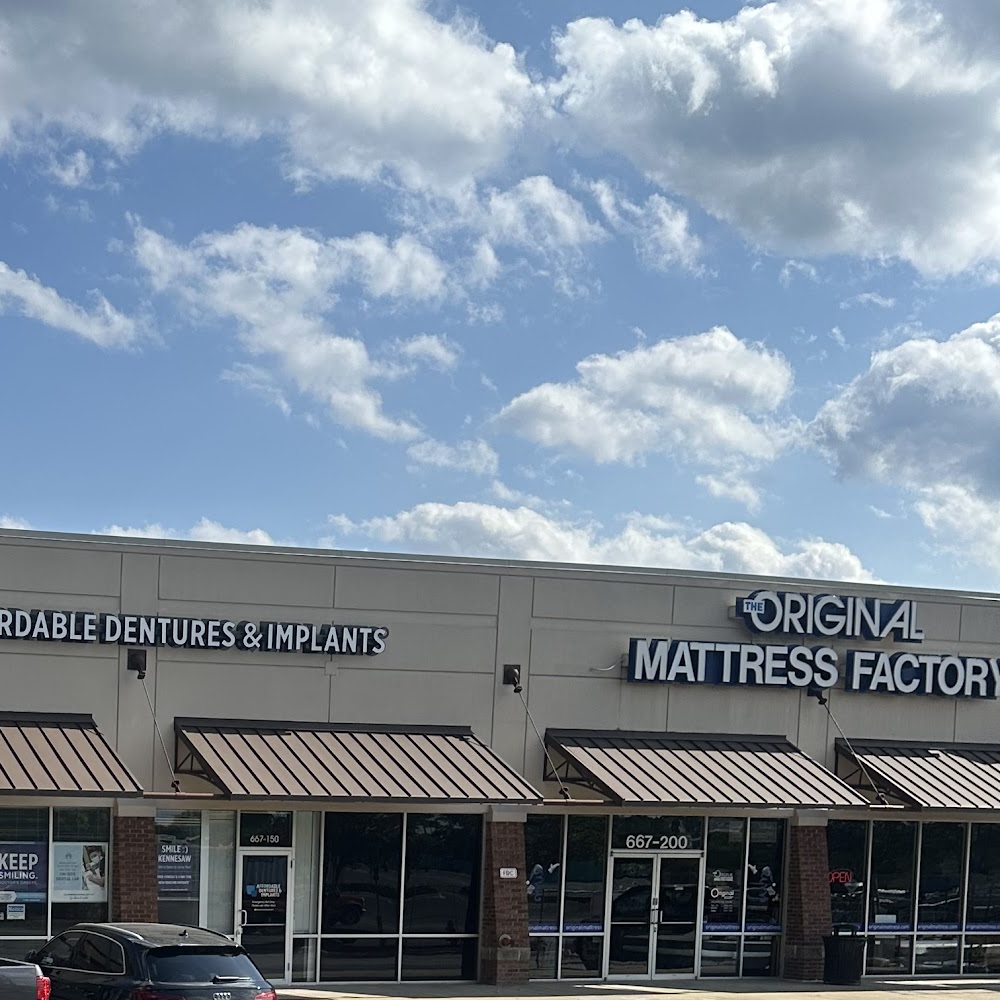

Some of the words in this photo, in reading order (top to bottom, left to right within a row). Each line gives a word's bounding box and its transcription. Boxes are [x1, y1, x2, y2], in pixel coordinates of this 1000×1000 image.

[744, 600, 764, 613] THE
[750, 590, 925, 640] ORIGINAL
[105, 614, 236, 648] DENTURES
[243, 622, 263, 648] &
[267, 623, 388, 654] IMPLANTS
[633, 639, 839, 688] MATTRESS
[852, 651, 1000, 698] FACTORY
[250, 834, 280, 843] 667-150
[625, 834, 688, 849] 667-200
[161, 845, 181, 853] SMILE
[158, 854, 192, 863] KENNESAW
